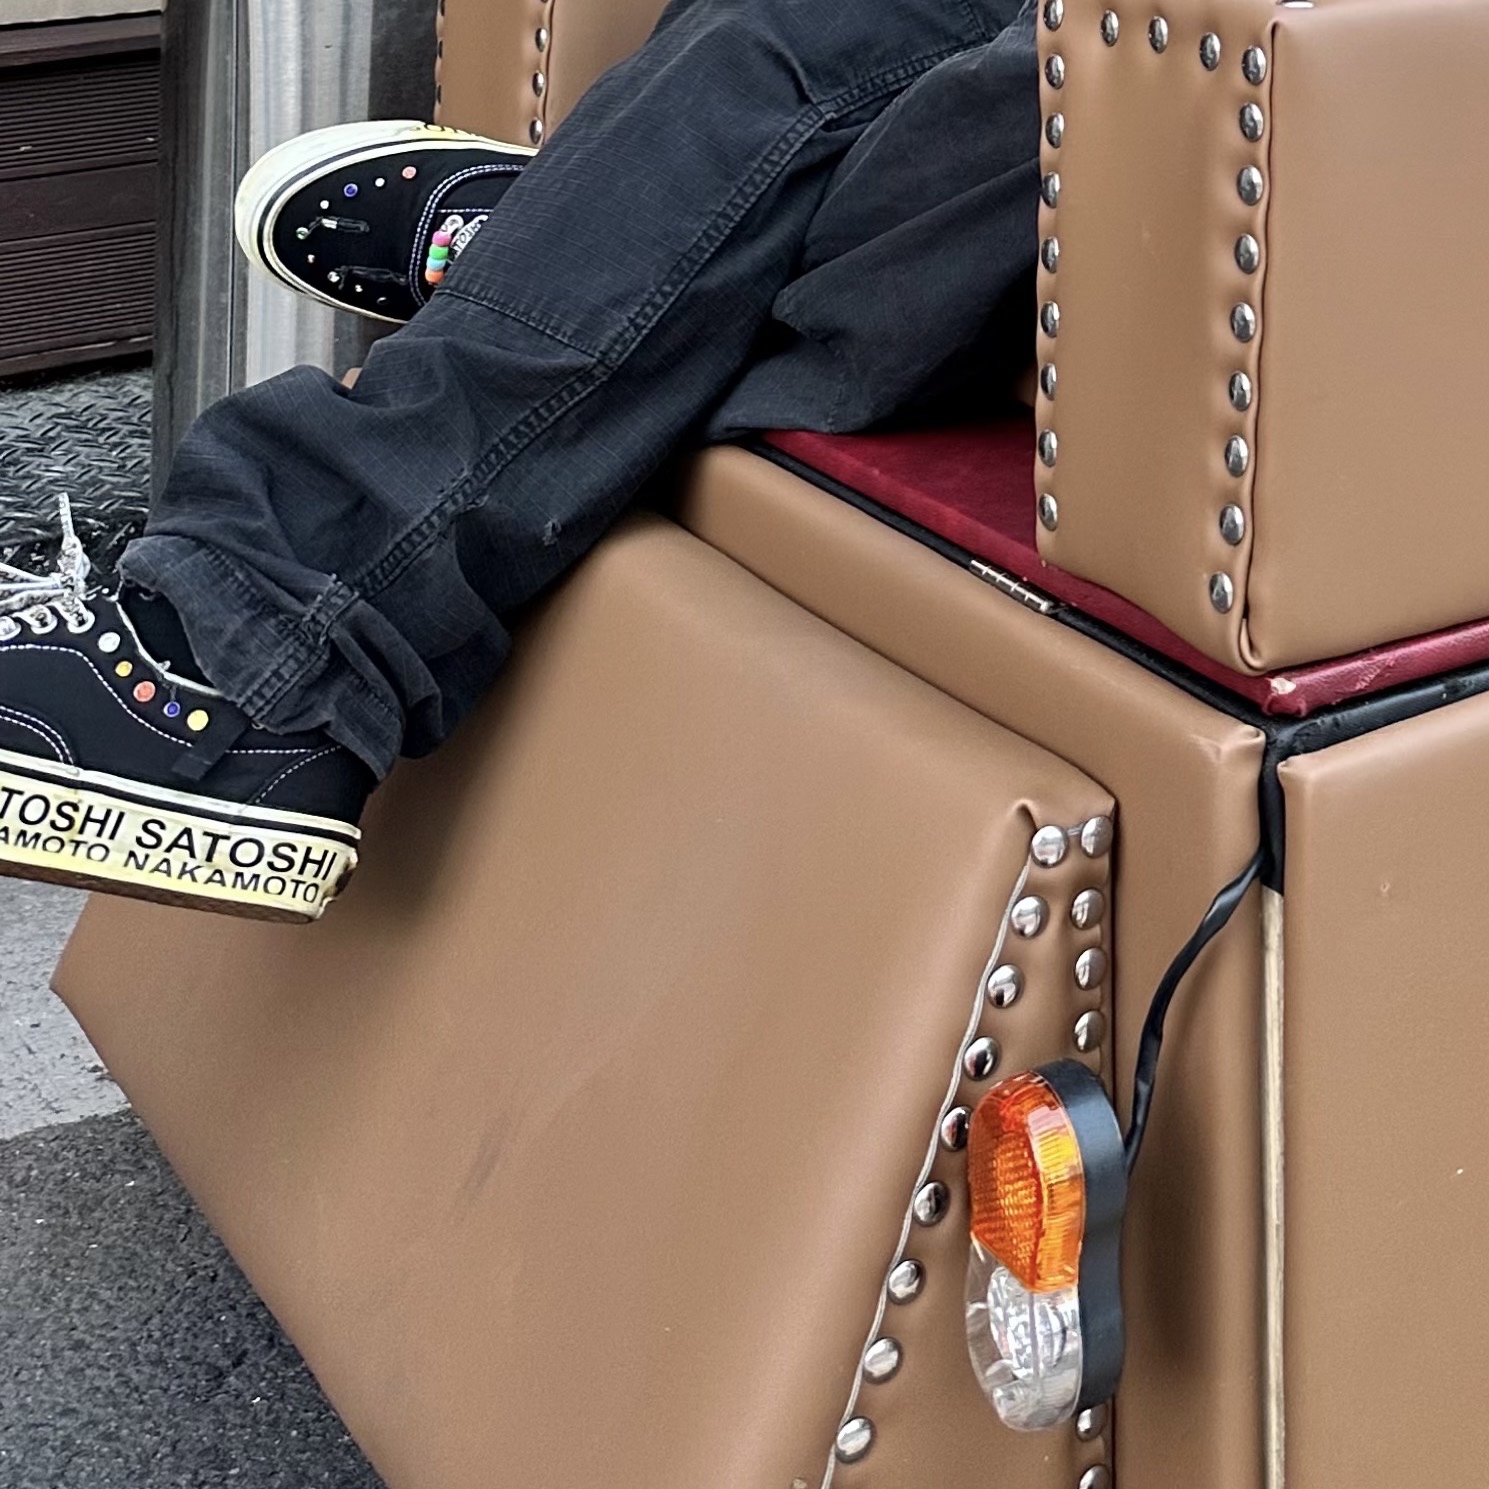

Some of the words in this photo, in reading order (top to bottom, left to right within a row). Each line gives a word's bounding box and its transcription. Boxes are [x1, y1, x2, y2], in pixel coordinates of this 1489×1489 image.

[0, 786, 125, 841] TOSHI
[135, 818, 337, 881] SATOSHI
[123, 850, 320, 904] NAKAMOTO
